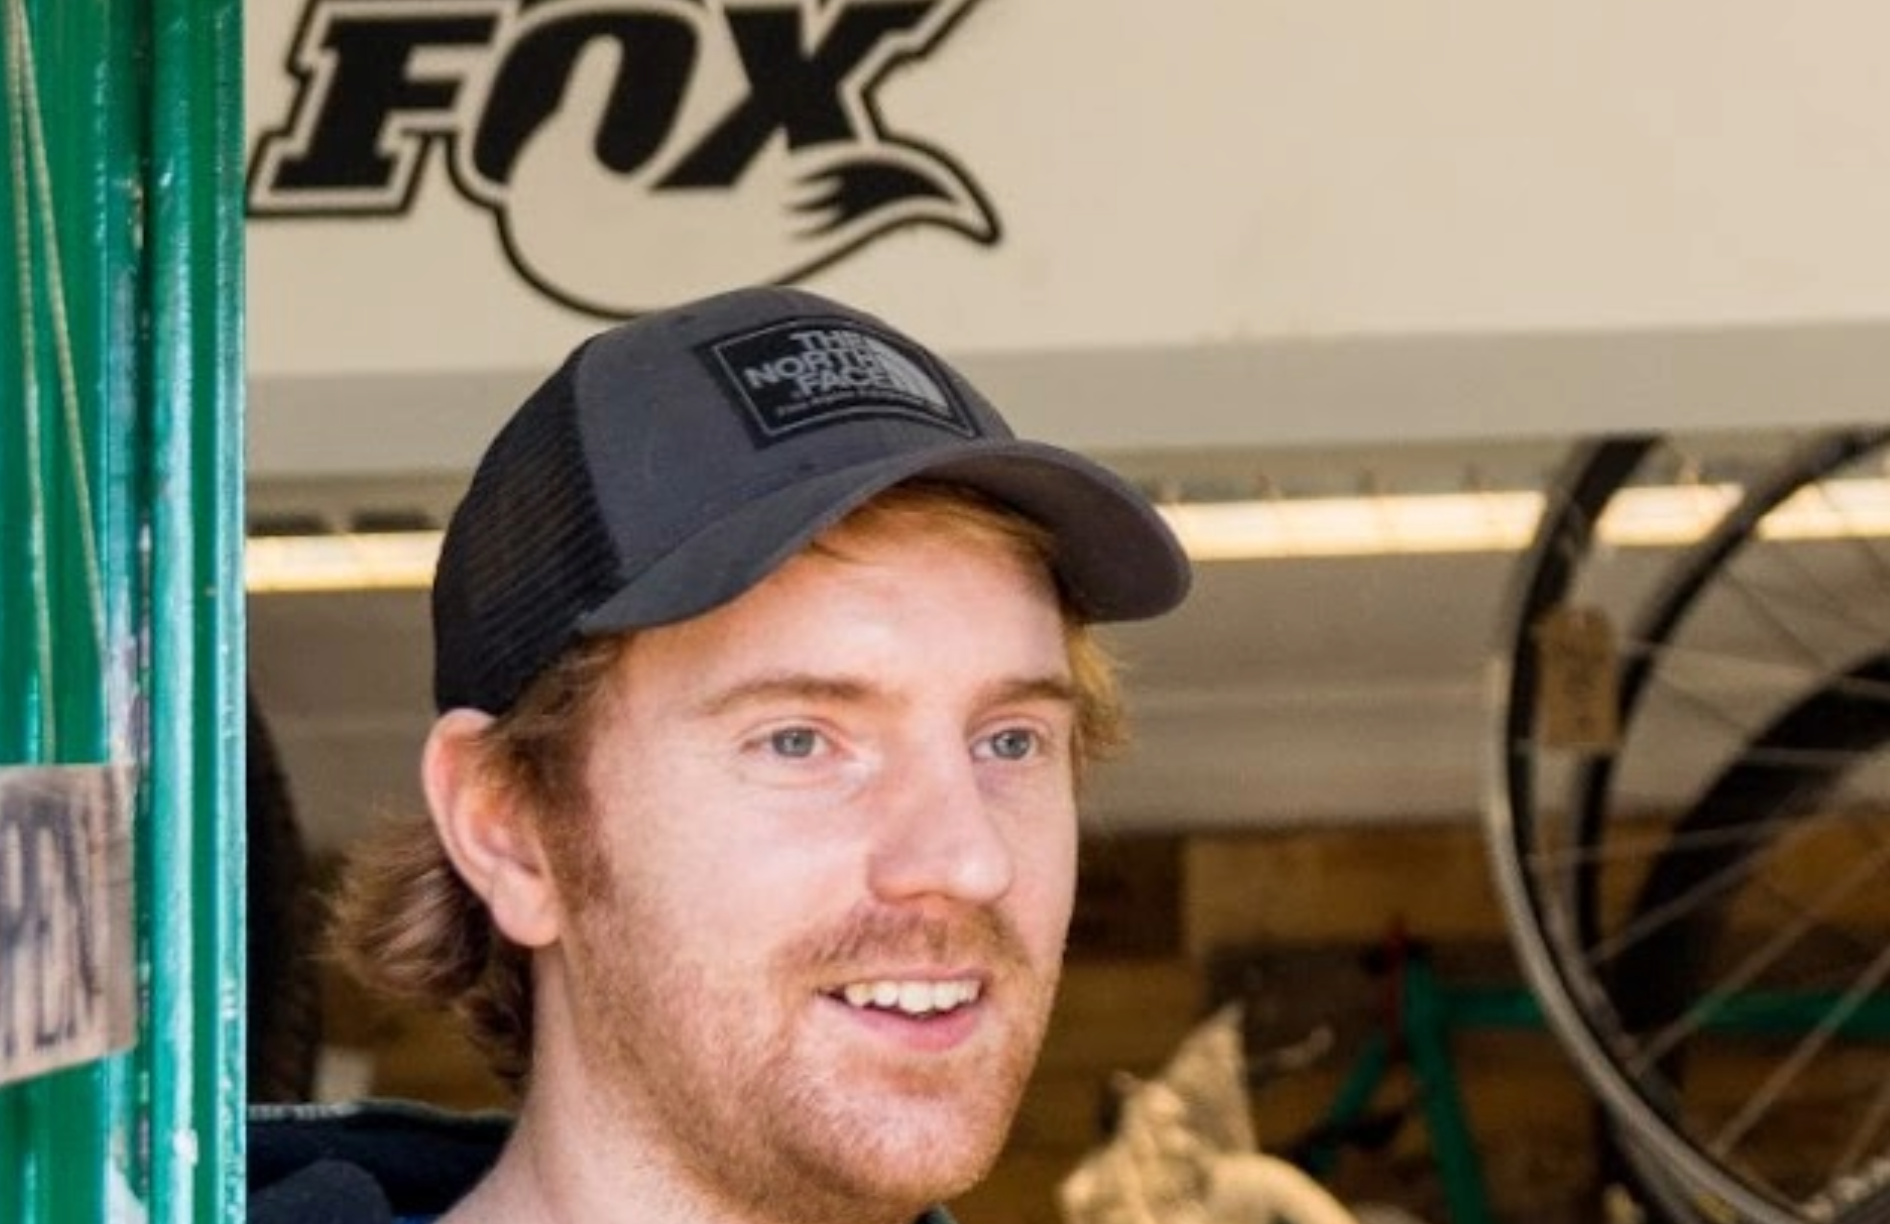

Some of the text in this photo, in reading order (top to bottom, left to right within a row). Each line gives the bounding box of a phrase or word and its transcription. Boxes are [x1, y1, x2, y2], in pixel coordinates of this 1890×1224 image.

[260, 2, 940, 202] FOX
[789, 329, 866, 352] THE
[744, 348, 880, 388] NORTH
[796, 367, 894, 396] FACE
